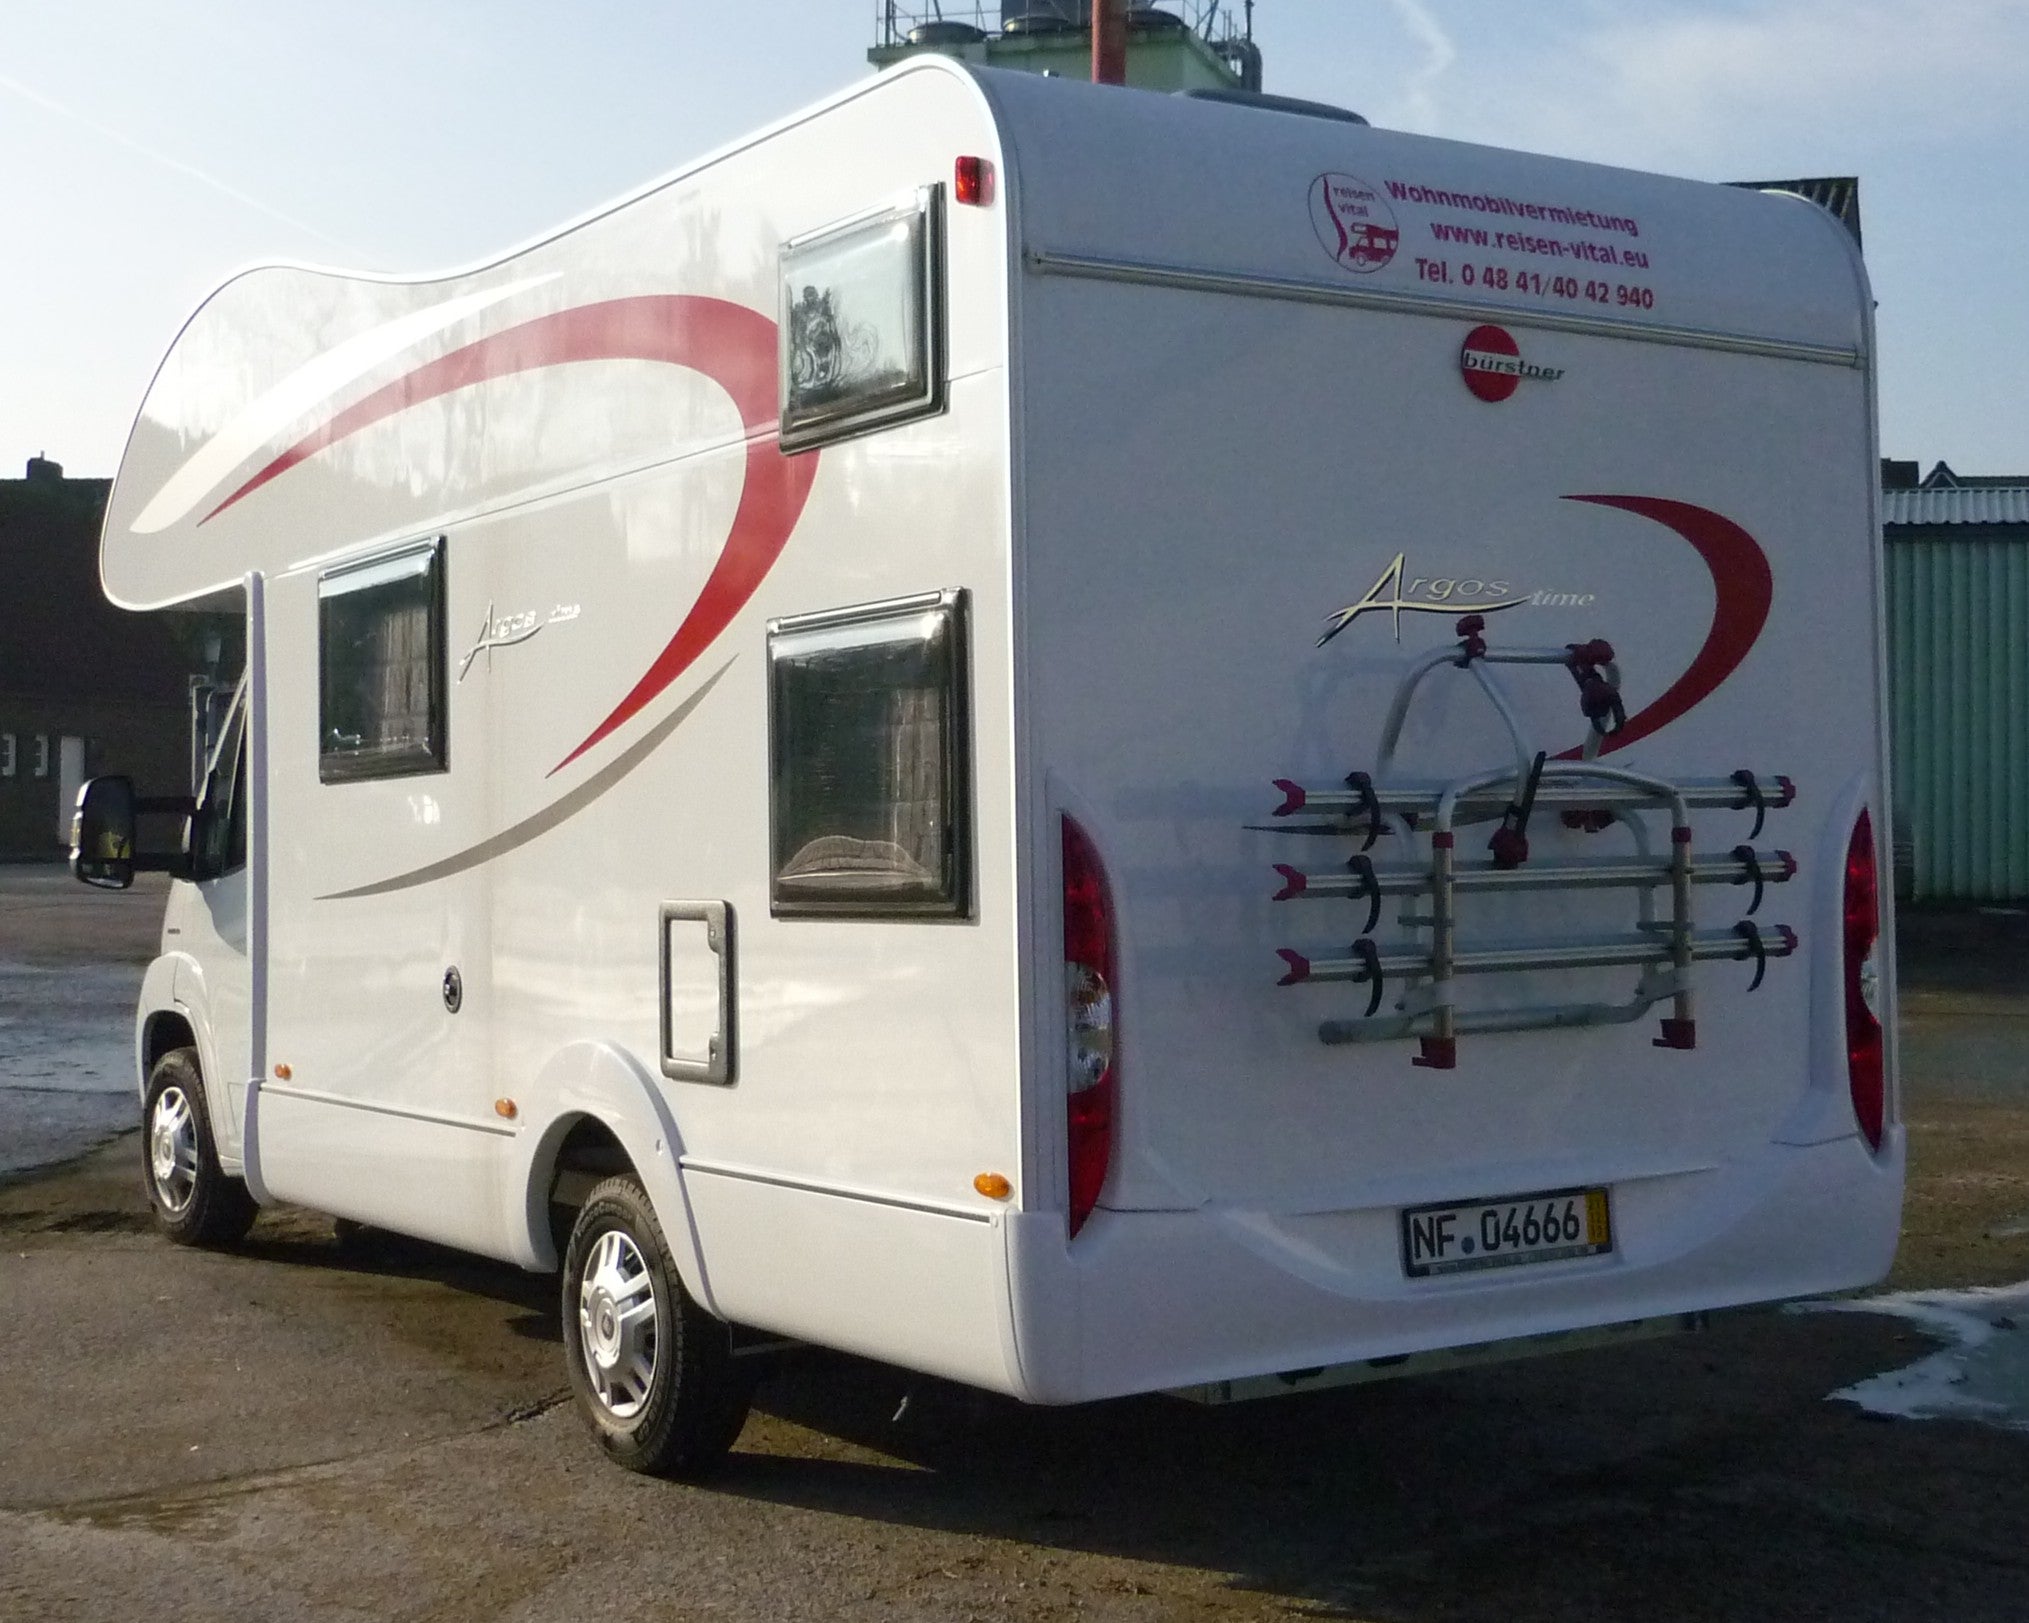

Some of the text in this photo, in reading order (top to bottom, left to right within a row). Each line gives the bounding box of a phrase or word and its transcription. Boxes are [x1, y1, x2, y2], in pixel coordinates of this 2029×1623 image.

[1333, 187, 1375, 202] reisen
[1338, 203, 1369, 217] vital
[1384, 180, 1639, 237] Wohnmobilvermietung
[1430, 222, 1650, 269] www.reisen-vital.eu
[1415, 257, 1654, 310] Tel. 0 48 41/40 42 940
[1464, 352, 1565, 380] bürstner
[1315, 552, 1595, 648] Argos time
[1412, 1213, 1457, 1260] NF
[1481, 1200, 1581, 1251] 04666
